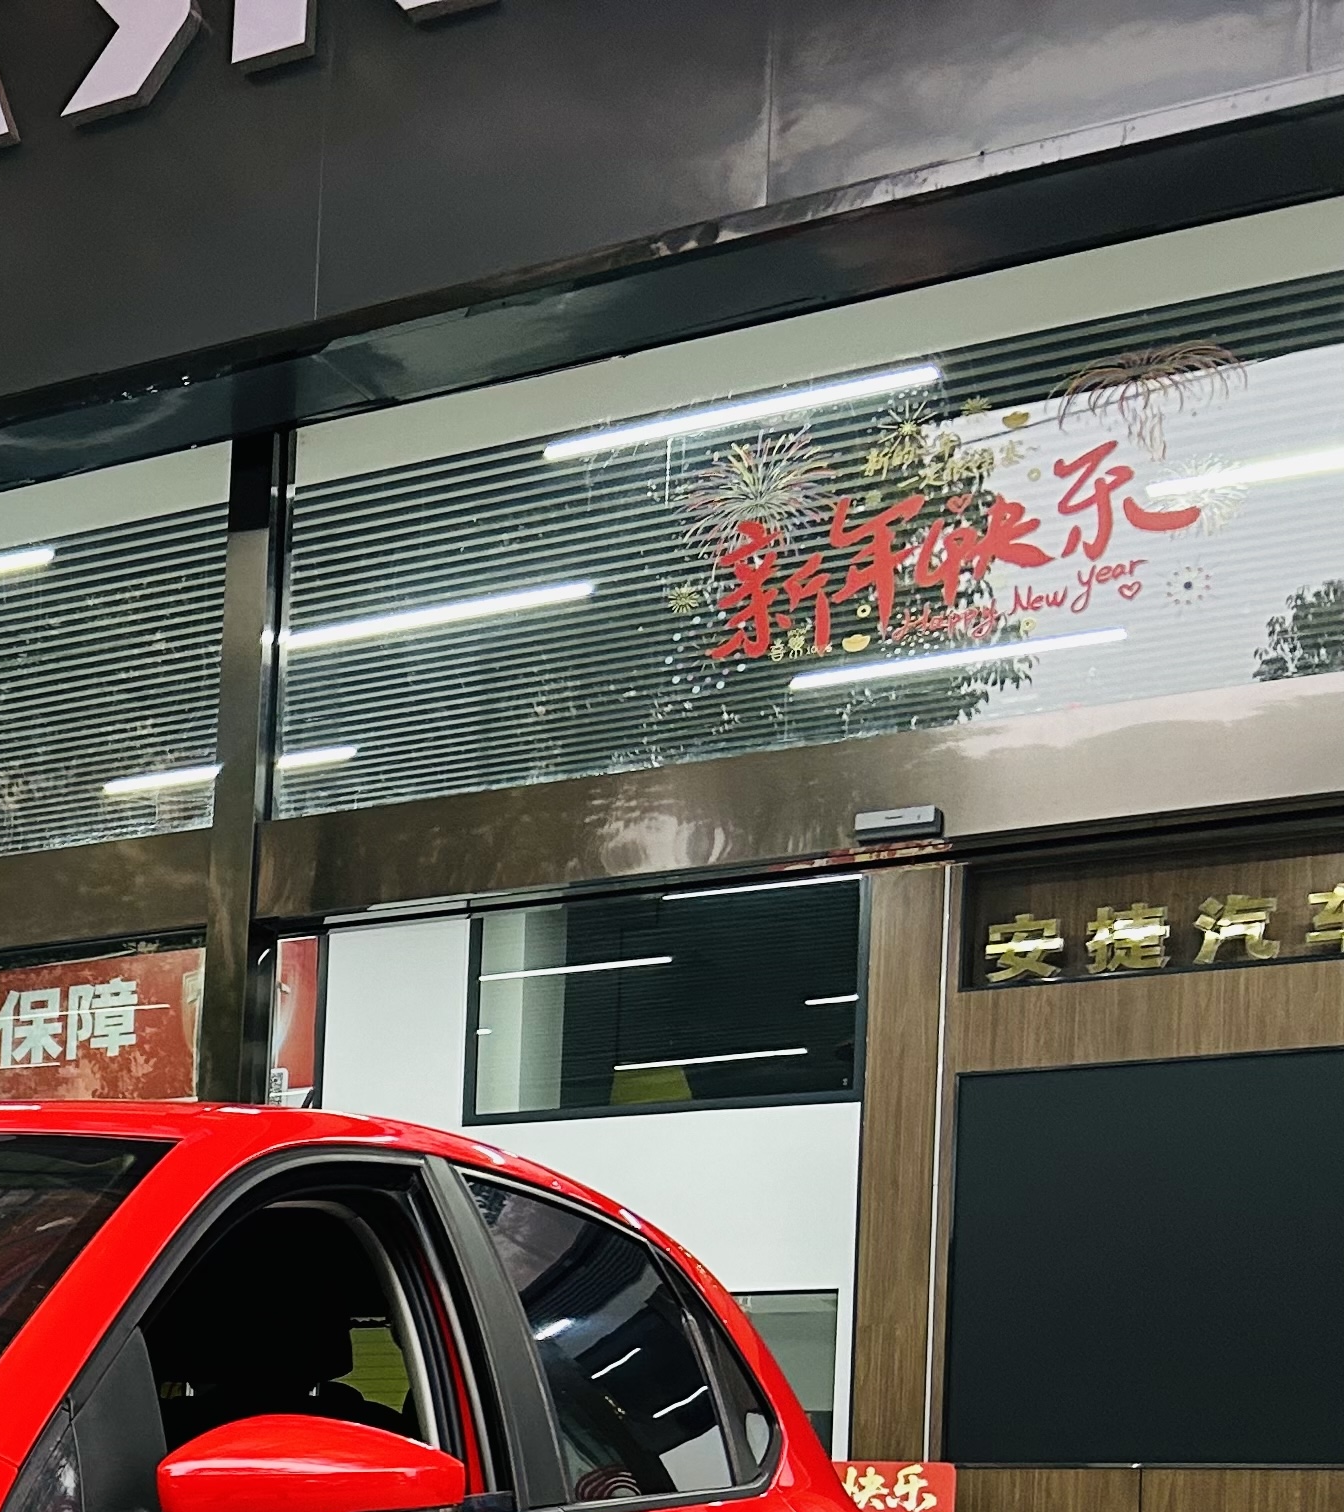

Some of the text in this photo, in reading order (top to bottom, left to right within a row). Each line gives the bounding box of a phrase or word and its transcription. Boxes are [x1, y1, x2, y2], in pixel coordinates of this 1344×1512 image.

[712, 440, 1201, 660] 新年快乐
[892, 598, 1000, 642] Happy
[1008, 585, 1069, 616] New
